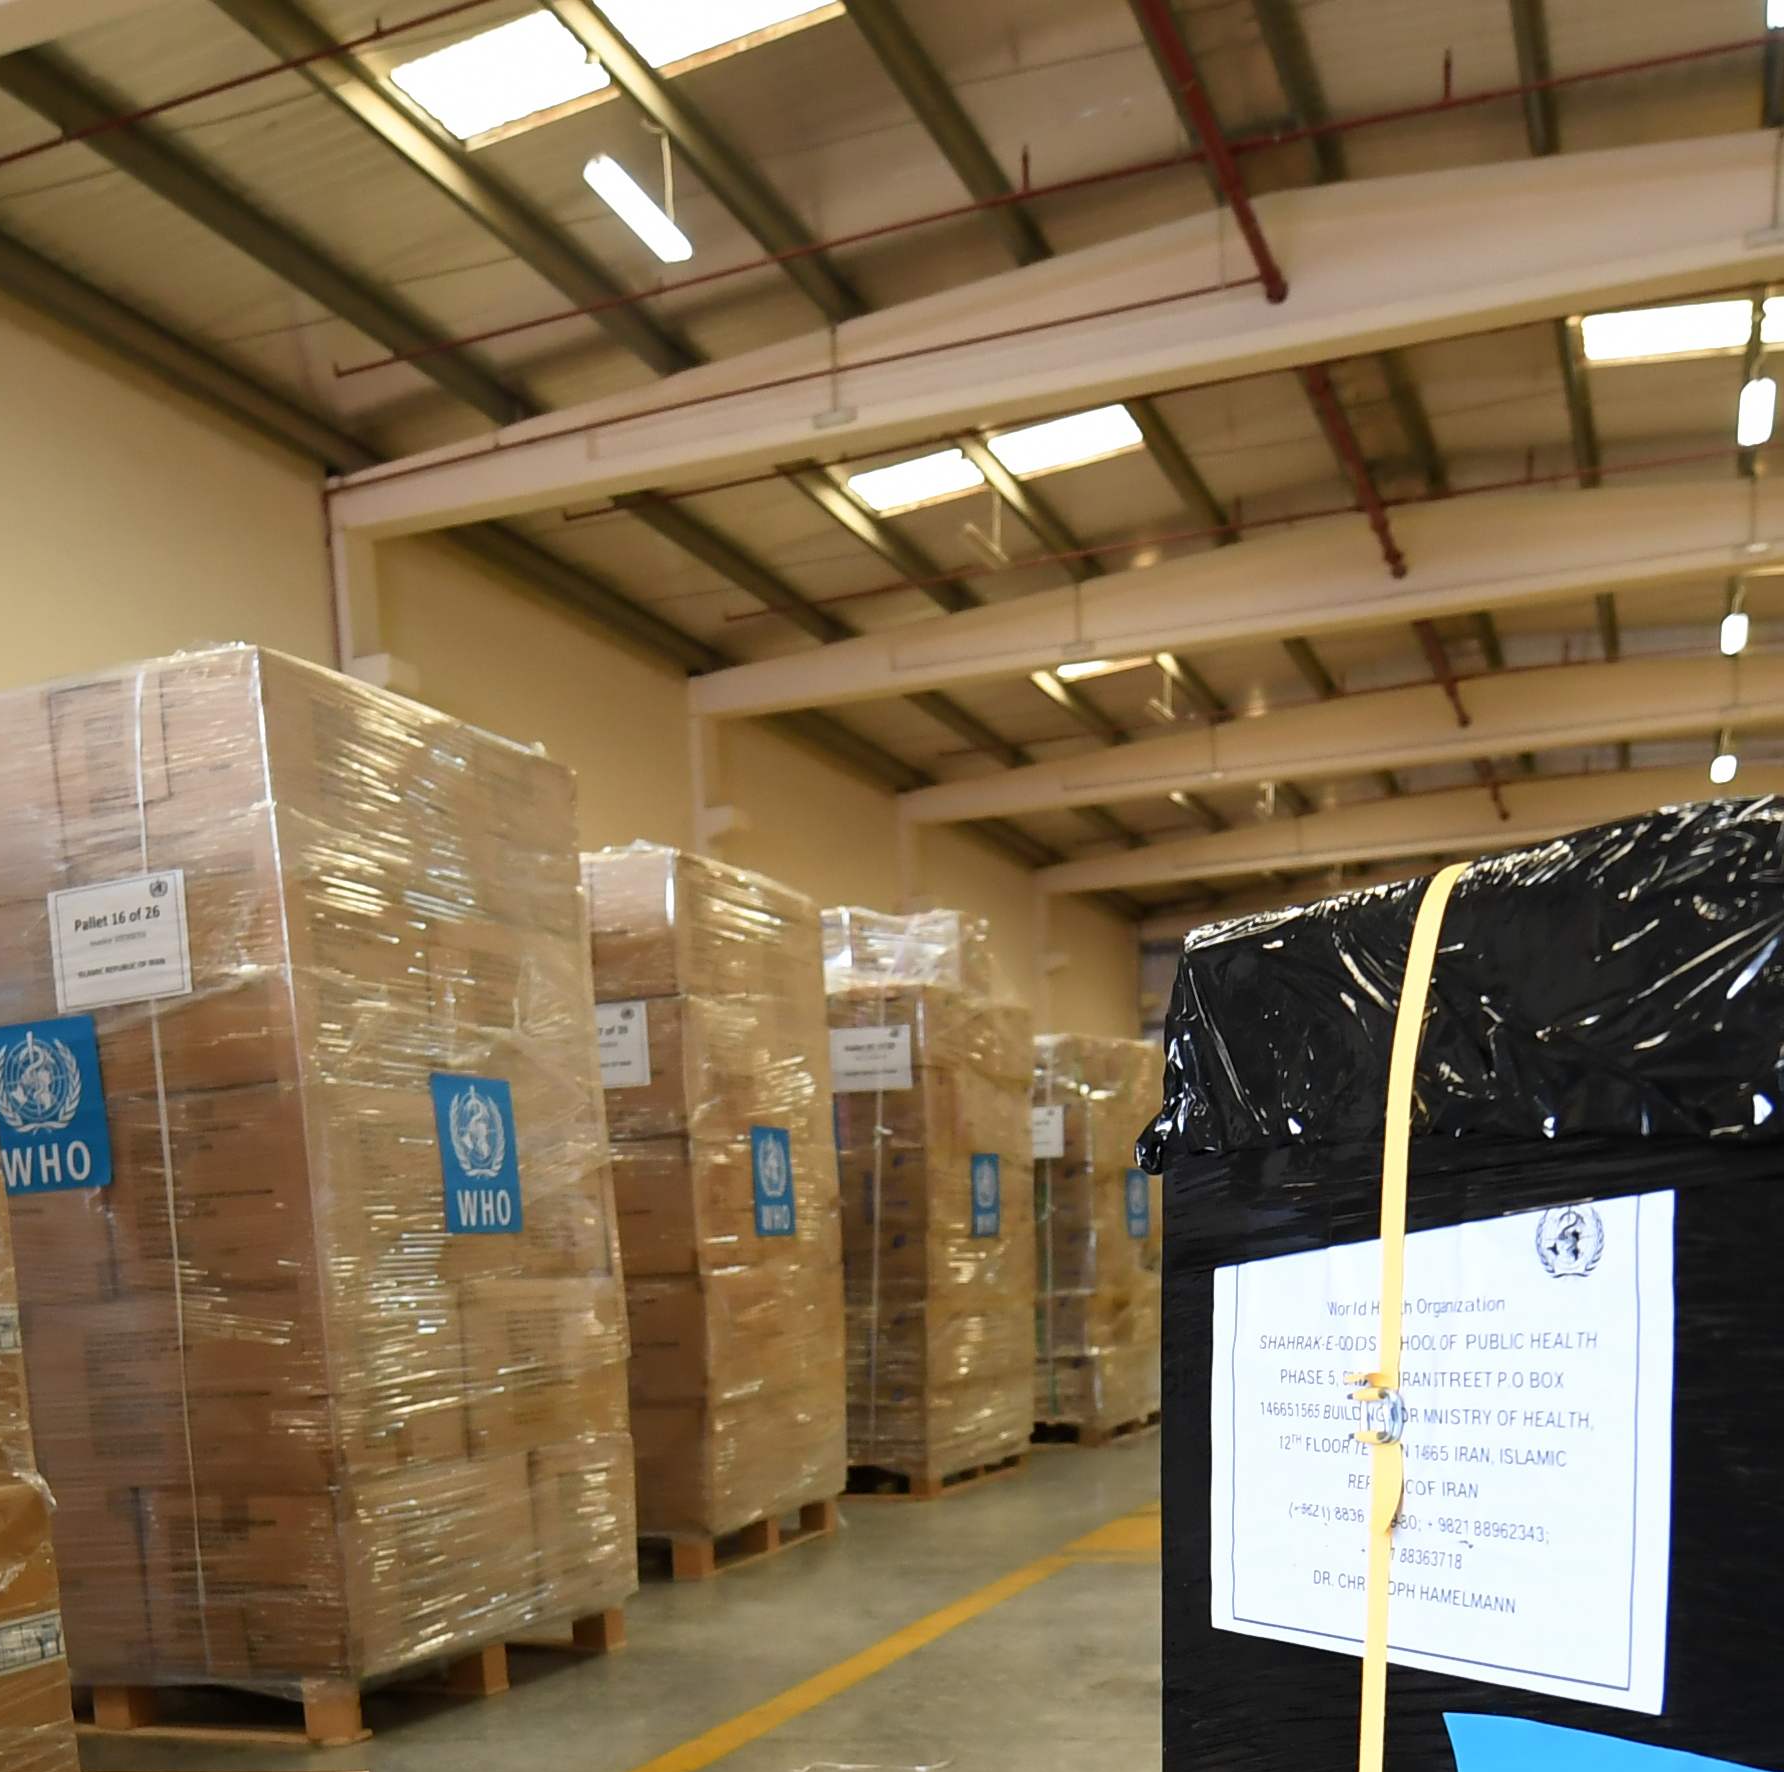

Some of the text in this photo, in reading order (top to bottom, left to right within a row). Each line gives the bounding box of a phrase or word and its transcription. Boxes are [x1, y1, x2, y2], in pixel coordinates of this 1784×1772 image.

[74, 905, 161, 932] Pallet 16 of 26
[1, 1140, 92, 1189] WHO
[456, 1188, 512, 1230] WHO
[1327, 1300, 1367, 1317] World
[1417, 1298, 1506, 1319] Organization
[1400, 1334, 1438, 1351] HOOL
[1440, 1334, 1457, 1351] OF
[1466, 1332, 1524, 1350] PUBLIC
[1530, 1331, 1598, 1350] HEALTH
[1280, 1369, 1324, 1385] PHASE
[1529, 1372, 1564, 1389] BOX
[1259, 1402, 1320, 1419] 146651565
[1497, 1410, 1517, 1426] OF
[1305, 1436, 1350, 1454] FLOOR
[1499, 1448, 1567, 1467] ISLAMIC
[1415, 1480, 1437, 1496] OF
[1441, 1481, 1479, 1498] IRAN
[1399, 1549, 1463, 1570] 88363718
[1338, 1573, 1416, 1600] CHROPH
[1420, 1586, 1516, 1614] HAMELMANN
